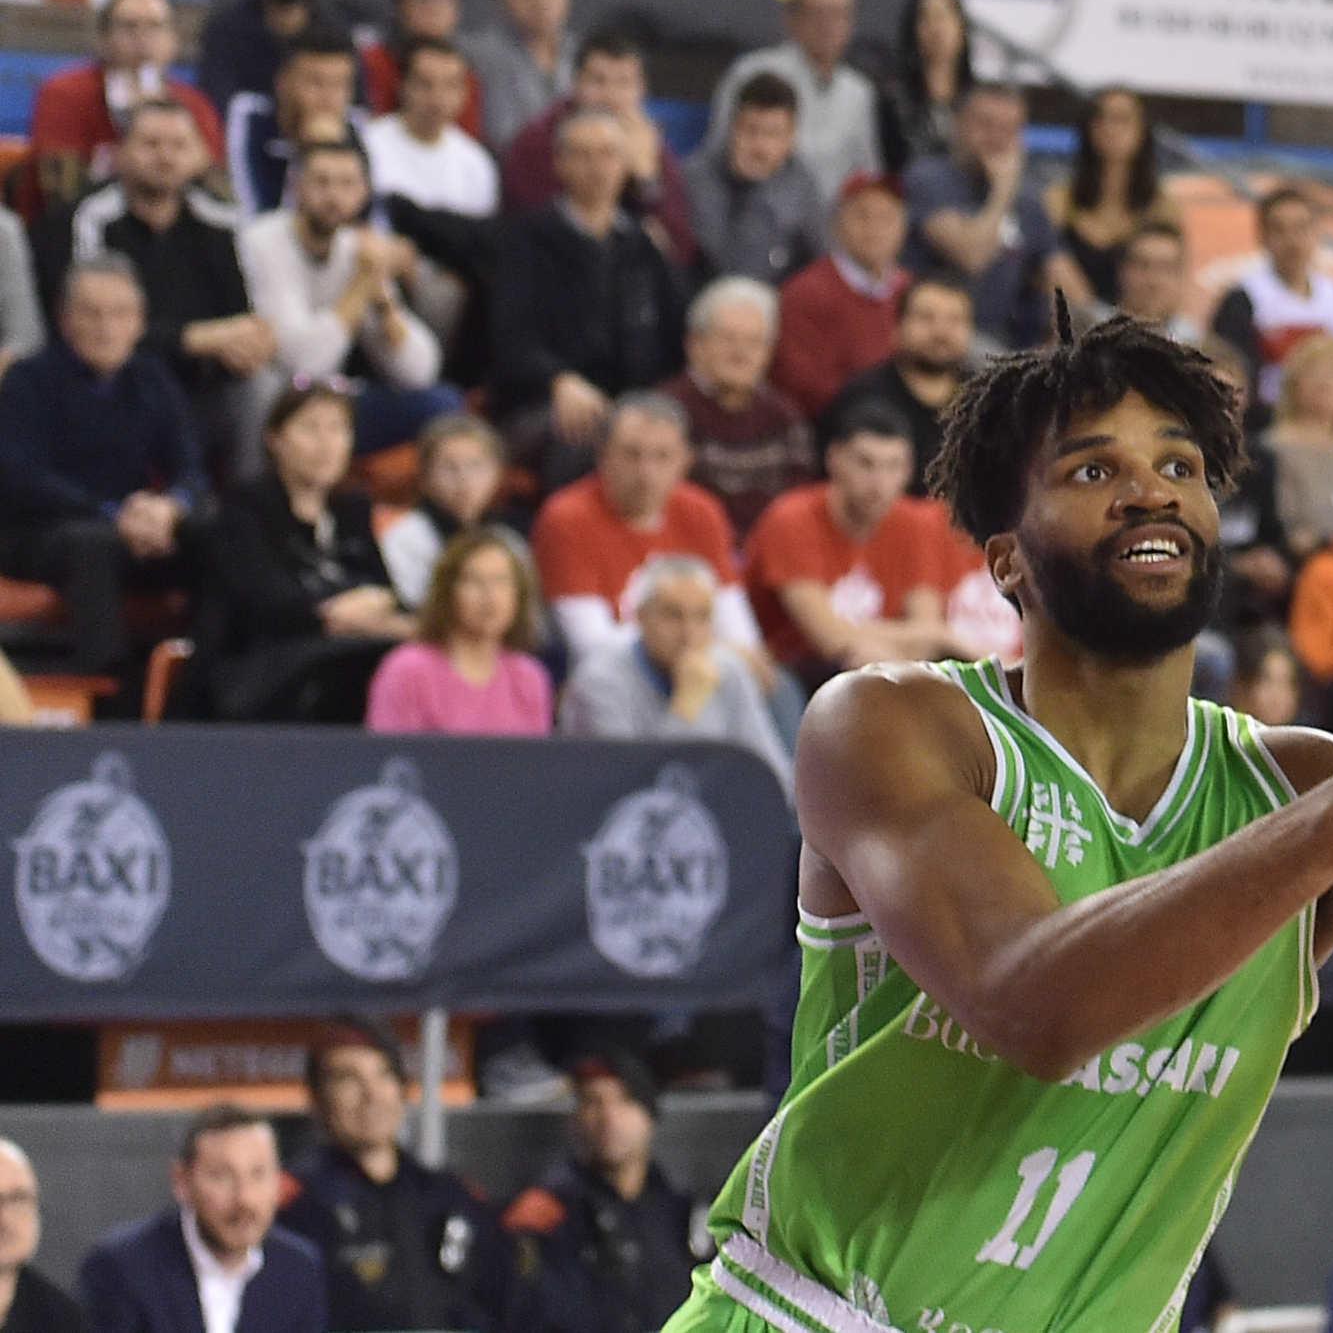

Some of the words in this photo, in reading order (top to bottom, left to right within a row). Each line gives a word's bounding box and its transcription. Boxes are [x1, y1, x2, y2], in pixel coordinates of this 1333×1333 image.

[29, 846, 157, 895] BAXI
[318, 850, 446, 898] BAXI
[1060, 1035, 1241, 1098] ASSARI
[975, 1146, 1097, 1270] 11
